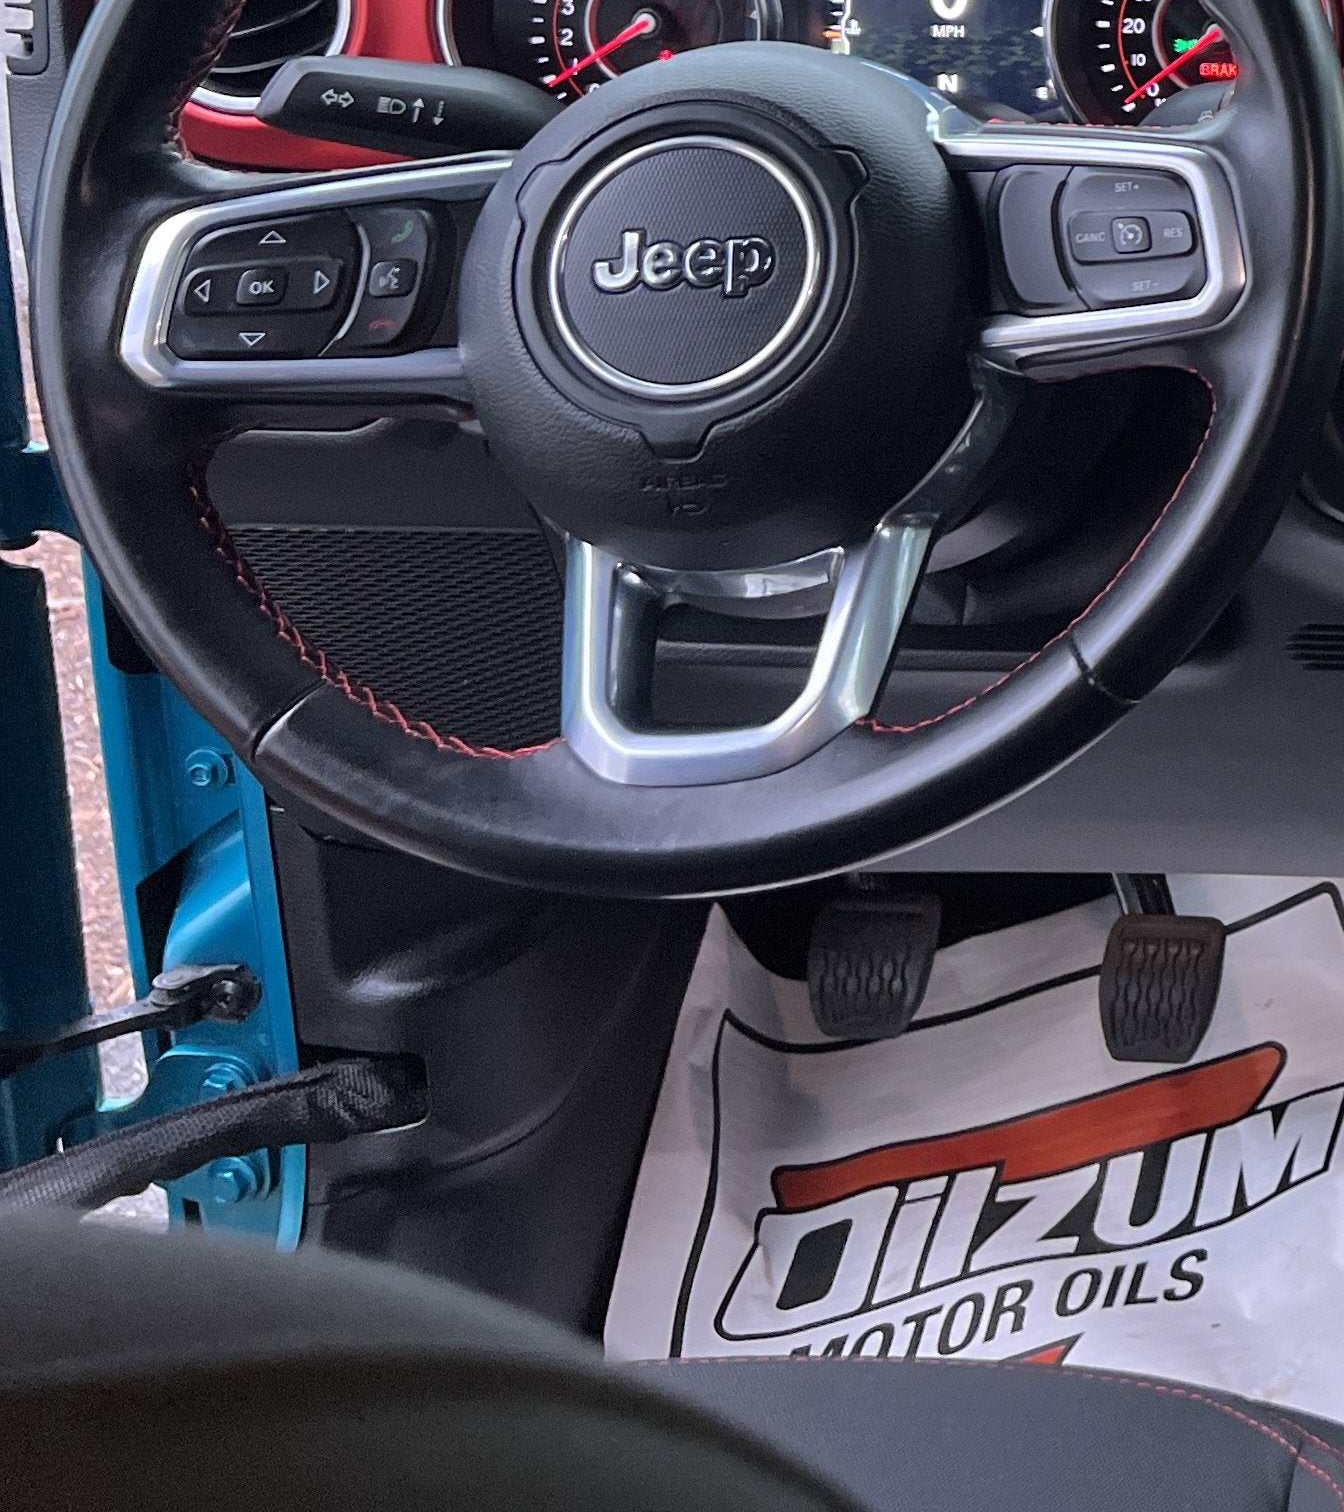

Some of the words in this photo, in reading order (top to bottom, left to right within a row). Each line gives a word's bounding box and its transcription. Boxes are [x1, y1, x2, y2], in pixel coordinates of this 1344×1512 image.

[931, 25, 965, 38] MPH
[1122, 18, 1146, 34] 20
[559, 28, 574, 47] 2
[1130, 53, 1147, 67] 10
[1199, 63, 1239, 79] BRAK
[937, 73, 959, 93] N
[1147, 82, 1160, 97] 0
[1075, 231, 1106, 244] CANC
[1163, 227, 1184, 238] RES
[592, 229, 777, 298] Jeep
[250, 280, 274, 295] OK
[1055, 1249, 1208, 1317] OILS
